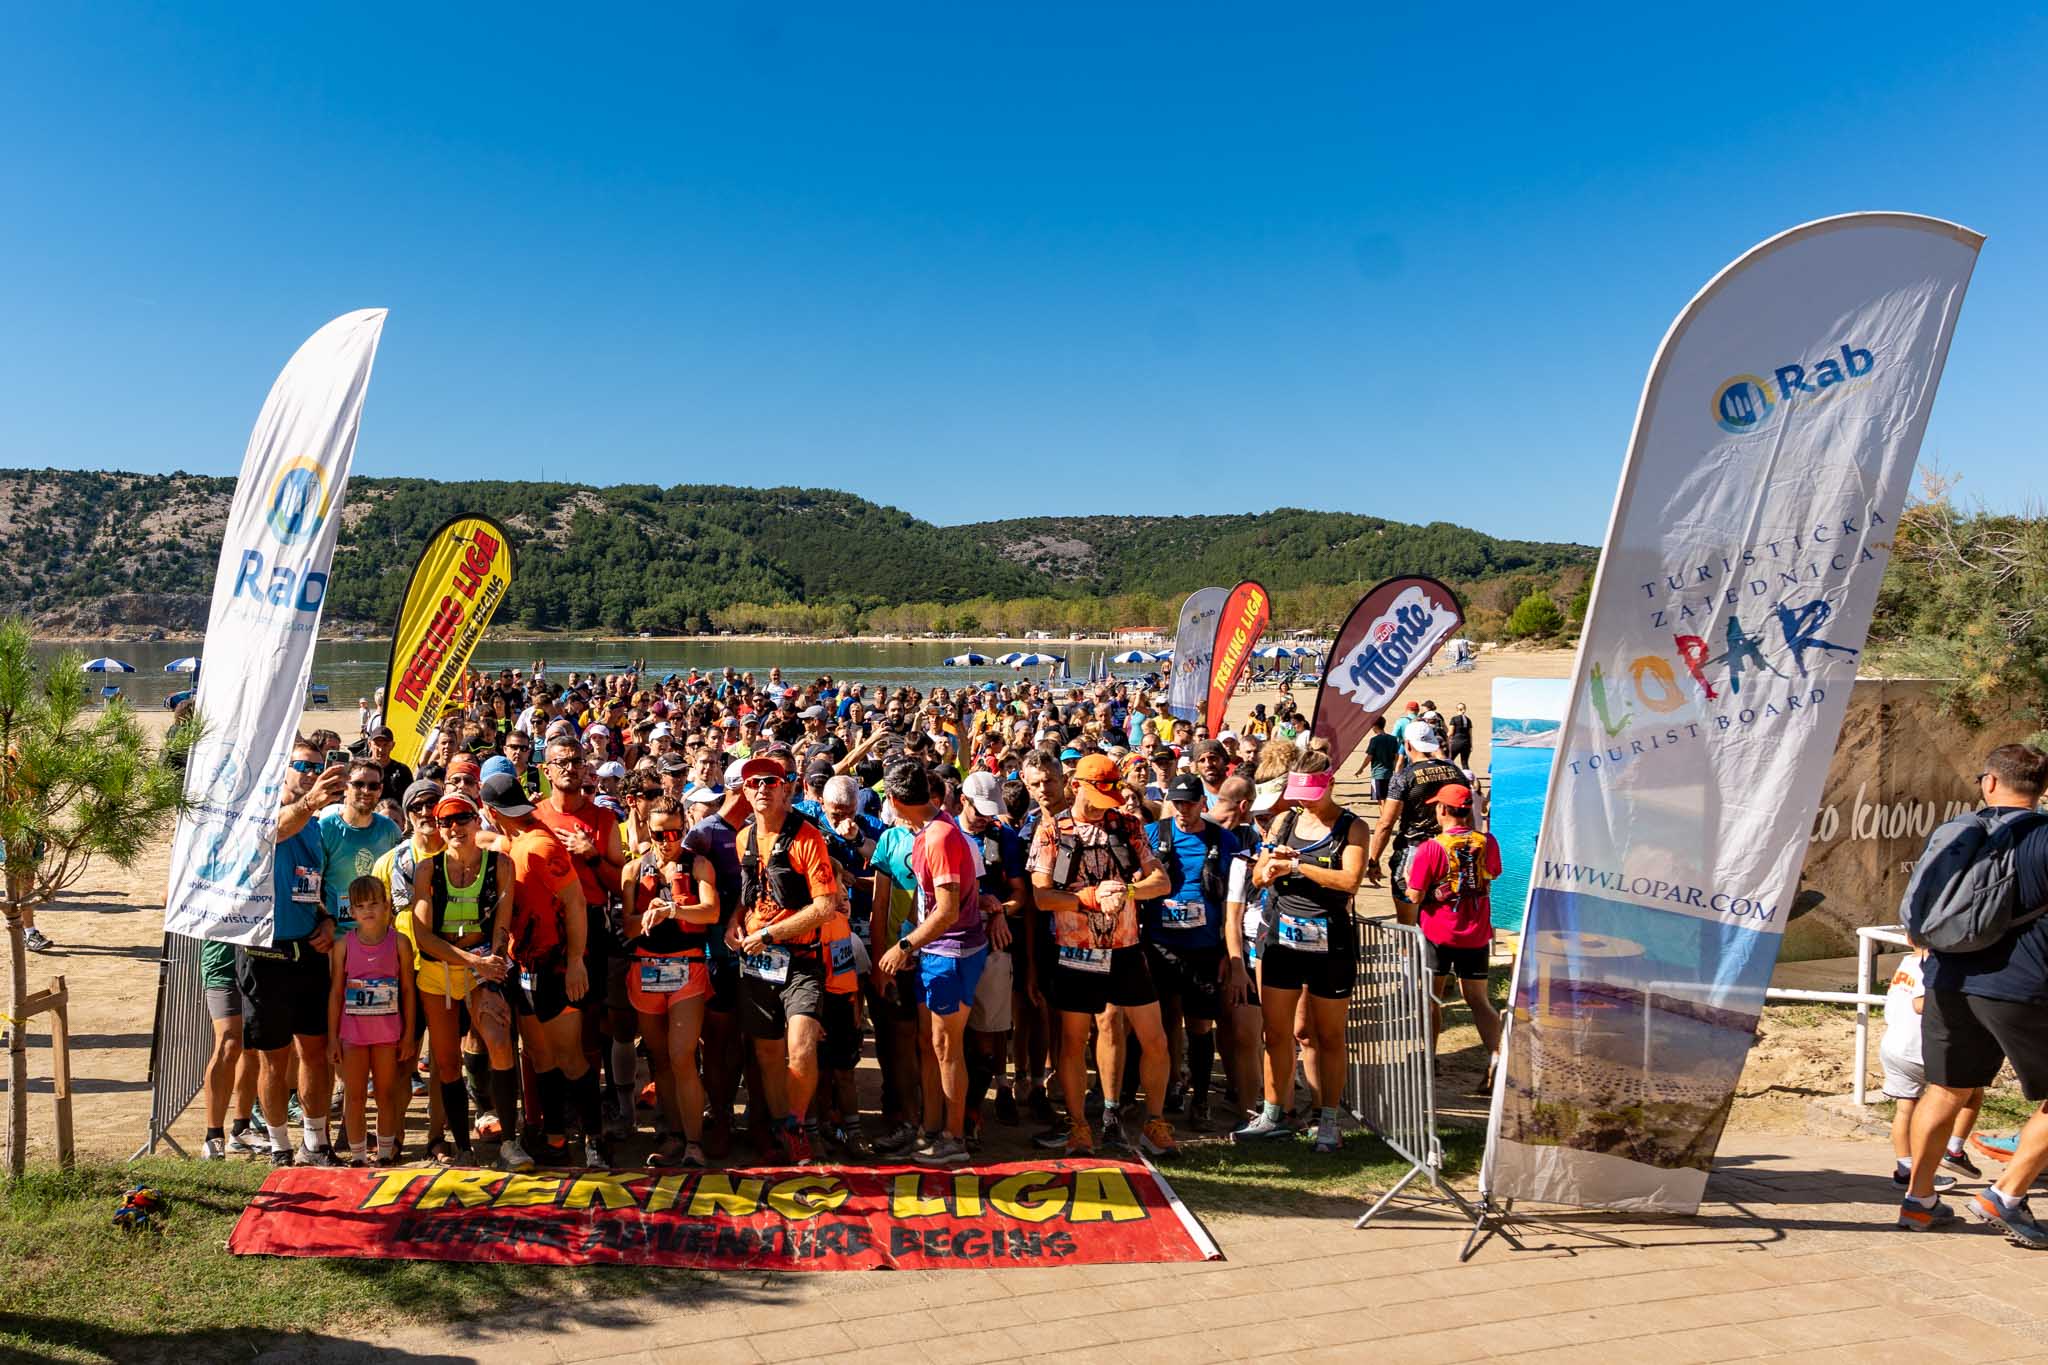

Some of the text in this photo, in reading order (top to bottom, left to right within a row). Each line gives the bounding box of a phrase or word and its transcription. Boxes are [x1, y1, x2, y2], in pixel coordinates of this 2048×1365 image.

[1775, 344, 1874, 401] Rab
[233, 549, 328, 612] Rab
[1640, 510, 1886, 599] TURISTIČKA
[394, 528, 500, 712] TREKING LIGA
[472, 574, 504, 624] BEGINS
[1651, 548, 1877, 629] ZAJEDNICA
[1213, 627, 1247, 693] TREKING
[1241, 589, 1264, 630] LIGA
[1350, 604, 1433, 696] Monte
[1590, 599, 1859, 738] LOPAR
[1568, 688, 1827, 776] TOURIST BOARD
[1852, 782, 1935, 841] know
[1543, 860, 1780, 923] WWW.LOPAR.COM
[1285, 926, 1302, 942] 43
[356, 990, 375, 1006] 97
[359, 1166, 1150, 1223] TREKING LIGA
[890, 1226, 1078, 1260] BEGINS
